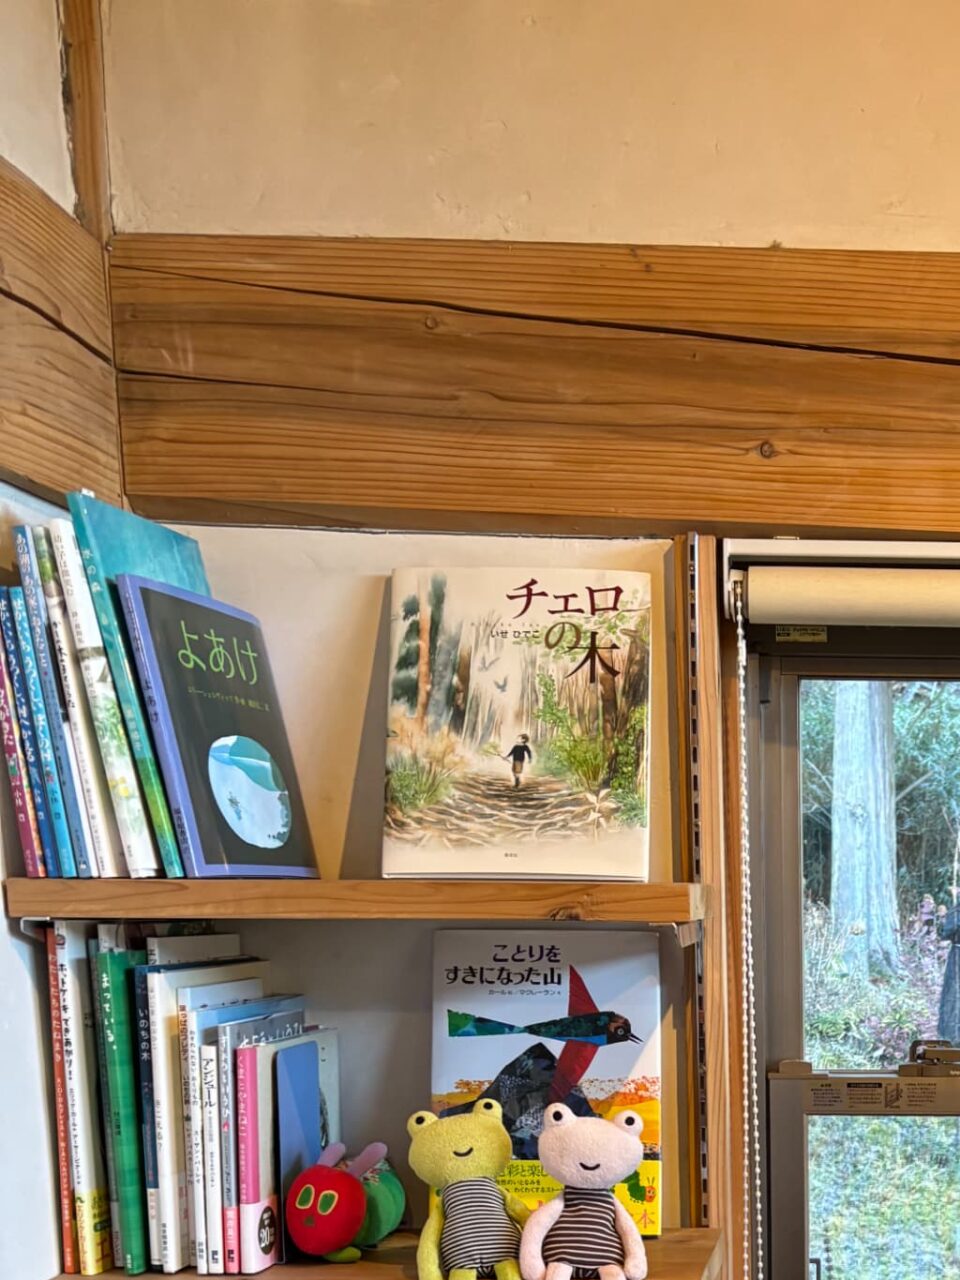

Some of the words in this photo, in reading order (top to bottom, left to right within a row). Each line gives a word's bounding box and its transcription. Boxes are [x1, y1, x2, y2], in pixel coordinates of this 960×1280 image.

[506, 578, 624, 619] チェロ
[177, 620, 258, 685] よあけ
[491, 630, 508, 638] いせ
[513, 630, 540, 638] ひでこ
[544, 621, 622, 684] の木
[445, 966, 562, 985] すきになった山
[492, 944, 561, 963] ことりを
[58, 964, 69, 1013] ホットケーキ
[102, 973, 117, 1050] まっている。
[139, 1009, 151, 1060] いのちの木
